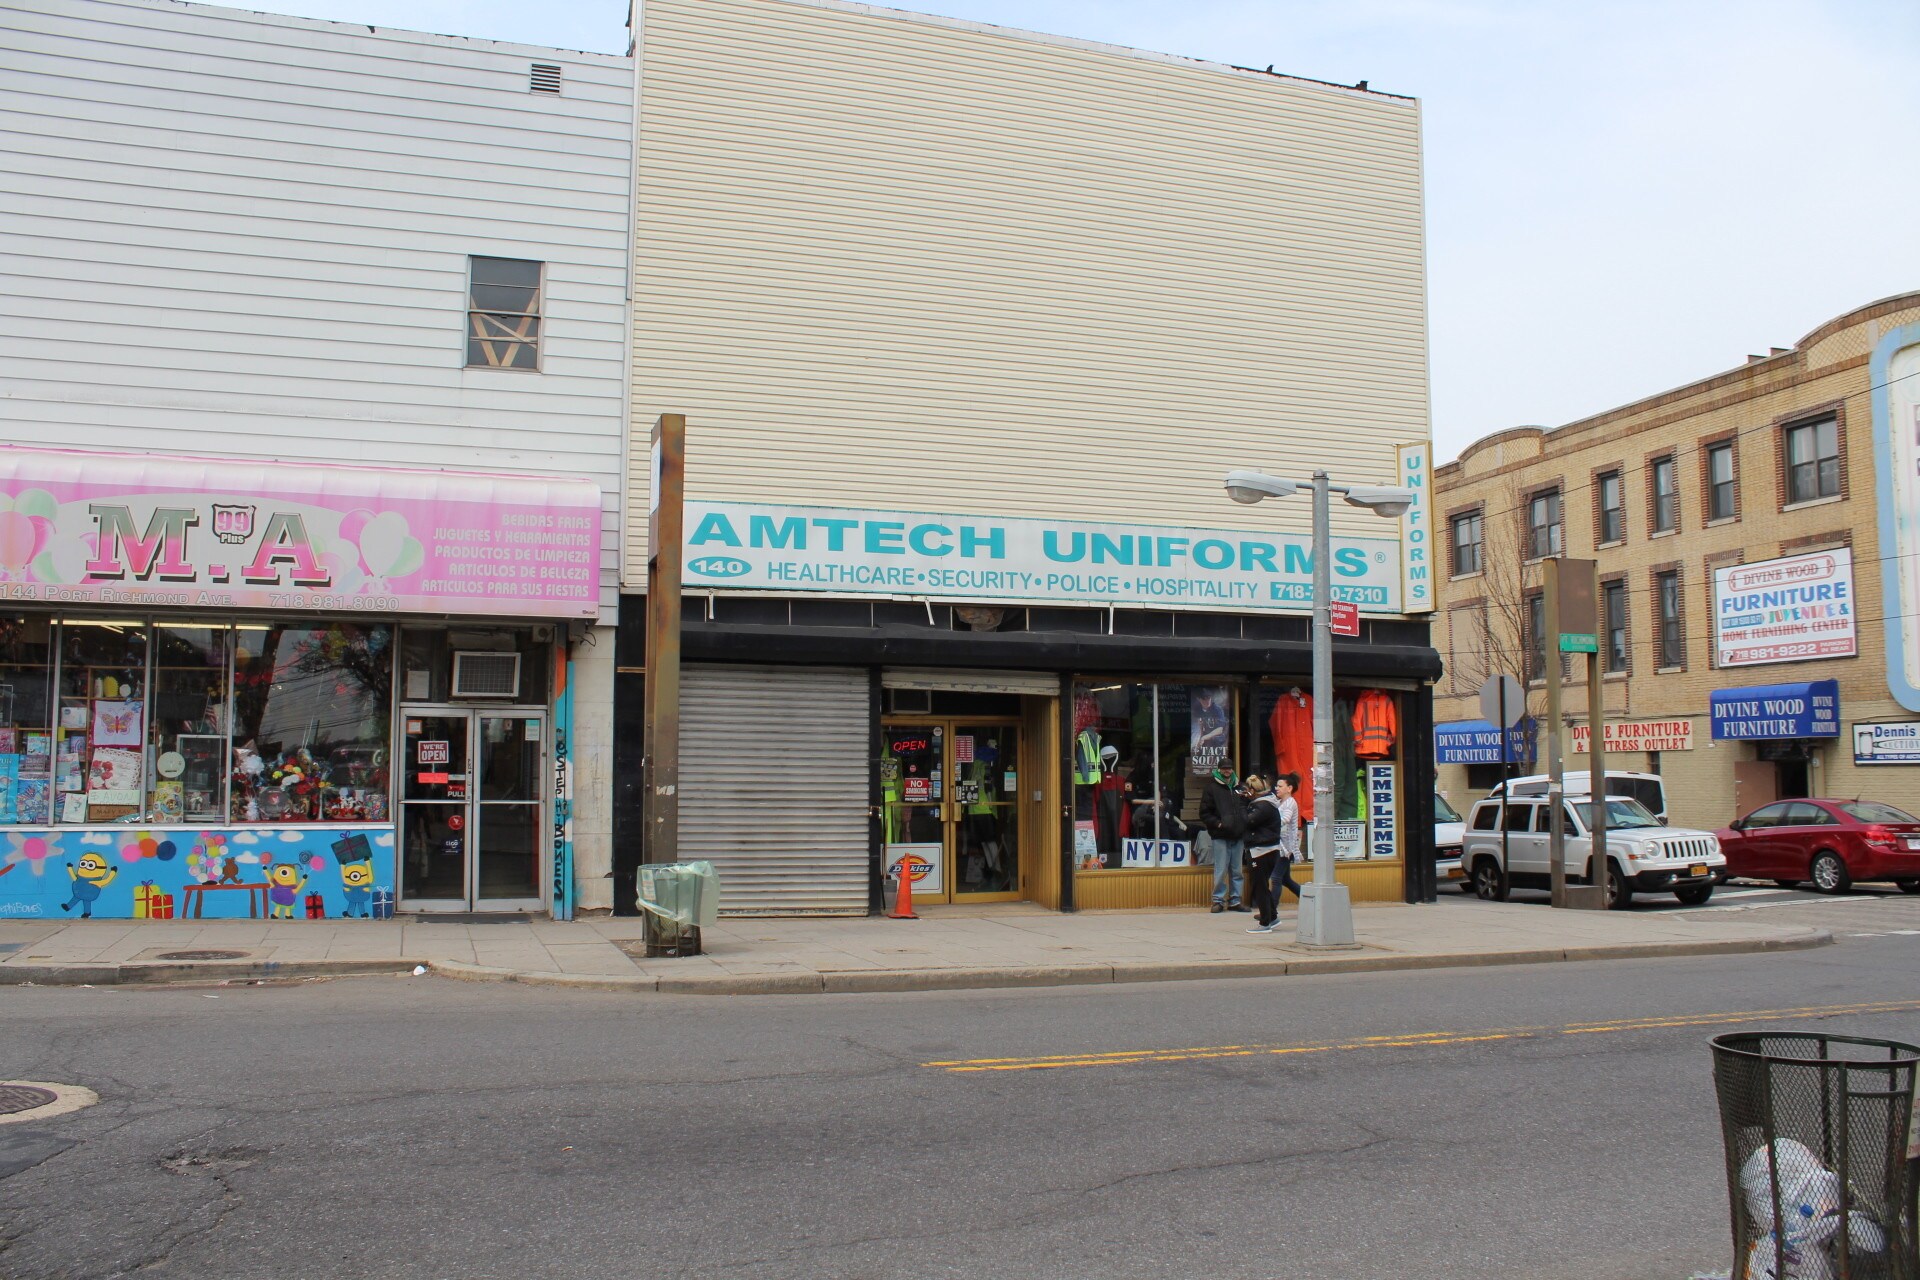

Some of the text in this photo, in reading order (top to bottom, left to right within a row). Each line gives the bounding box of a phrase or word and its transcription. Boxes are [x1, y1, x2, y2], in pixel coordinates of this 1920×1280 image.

[216, 510, 250, 531] 99
[502, 514, 591, 529] BEBIDAS FRIAS
[1406, 456, 1426, 598] UNIFORMS
[220, 532, 245, 545] Plus
[433, 528, 590, 546] JUGUETES Y HERRAMIENTAS
[688, 512, 1005, 559] AMTECH
[1043, 530, 1369, 578] UNIFORMS
[435, 545, 590, 563] PRODUCTOS DE LIMPIEZA
[449, 563, 589, 580] ARTICULOS DE BELLEZA
[695, 560, 743, 574] 140
[1744, 563, 1818, 585] DIVINE WOOD
[422, 579, 588, 597] ARTICULOS PARA SUS FIESTAS
[768, 562, 1258, 599] HEALTHCARE SECURITY POLICE HOSPITALITY
[0, 584, 37, 599] 144
[1276, 584, 1382, 603] 718-0-7310
[1722, 582, 1846, 613] FURNITURE
[269, 594, 399, 610] 718.981.8090
[1839, 603, 1848, 615] &
[1722, 618, 1848, 642] HOME FURNISHING CENTER
[1750, 643, 1817, 659] 981-9222
[1714, 699, 1804, 718] DIVINE WOOD
[1812, 696, 1833, 707] DIVINE
[1815, 709, 1832, 720] WOOD
[1573, 722, 1690, 739] DIVE FURNITURE
[1723, 719, 1796, 736] FURNITURE
[1812, 722, 1836, 733] FURNITURE
[1874, 725, 1916, 737] Dennis
[893, 740, 926, 752] OPEN
[1438, 734, 1472, 746] DIVINE
[1577, 742, 1583, 752] &
[1645, 738, 1686, 750] OUTLET
[421, 750, 446, 760] OPEN
[1201, 747, 1228, 756] TACT
[1445, 749, 1498, 761] FURNITURE
[1192, 756, 1227, 765] SQUA
[1372, 767, 1393, 854] EMBLEMS
[1127, 841, 1185, 862] NYPD
